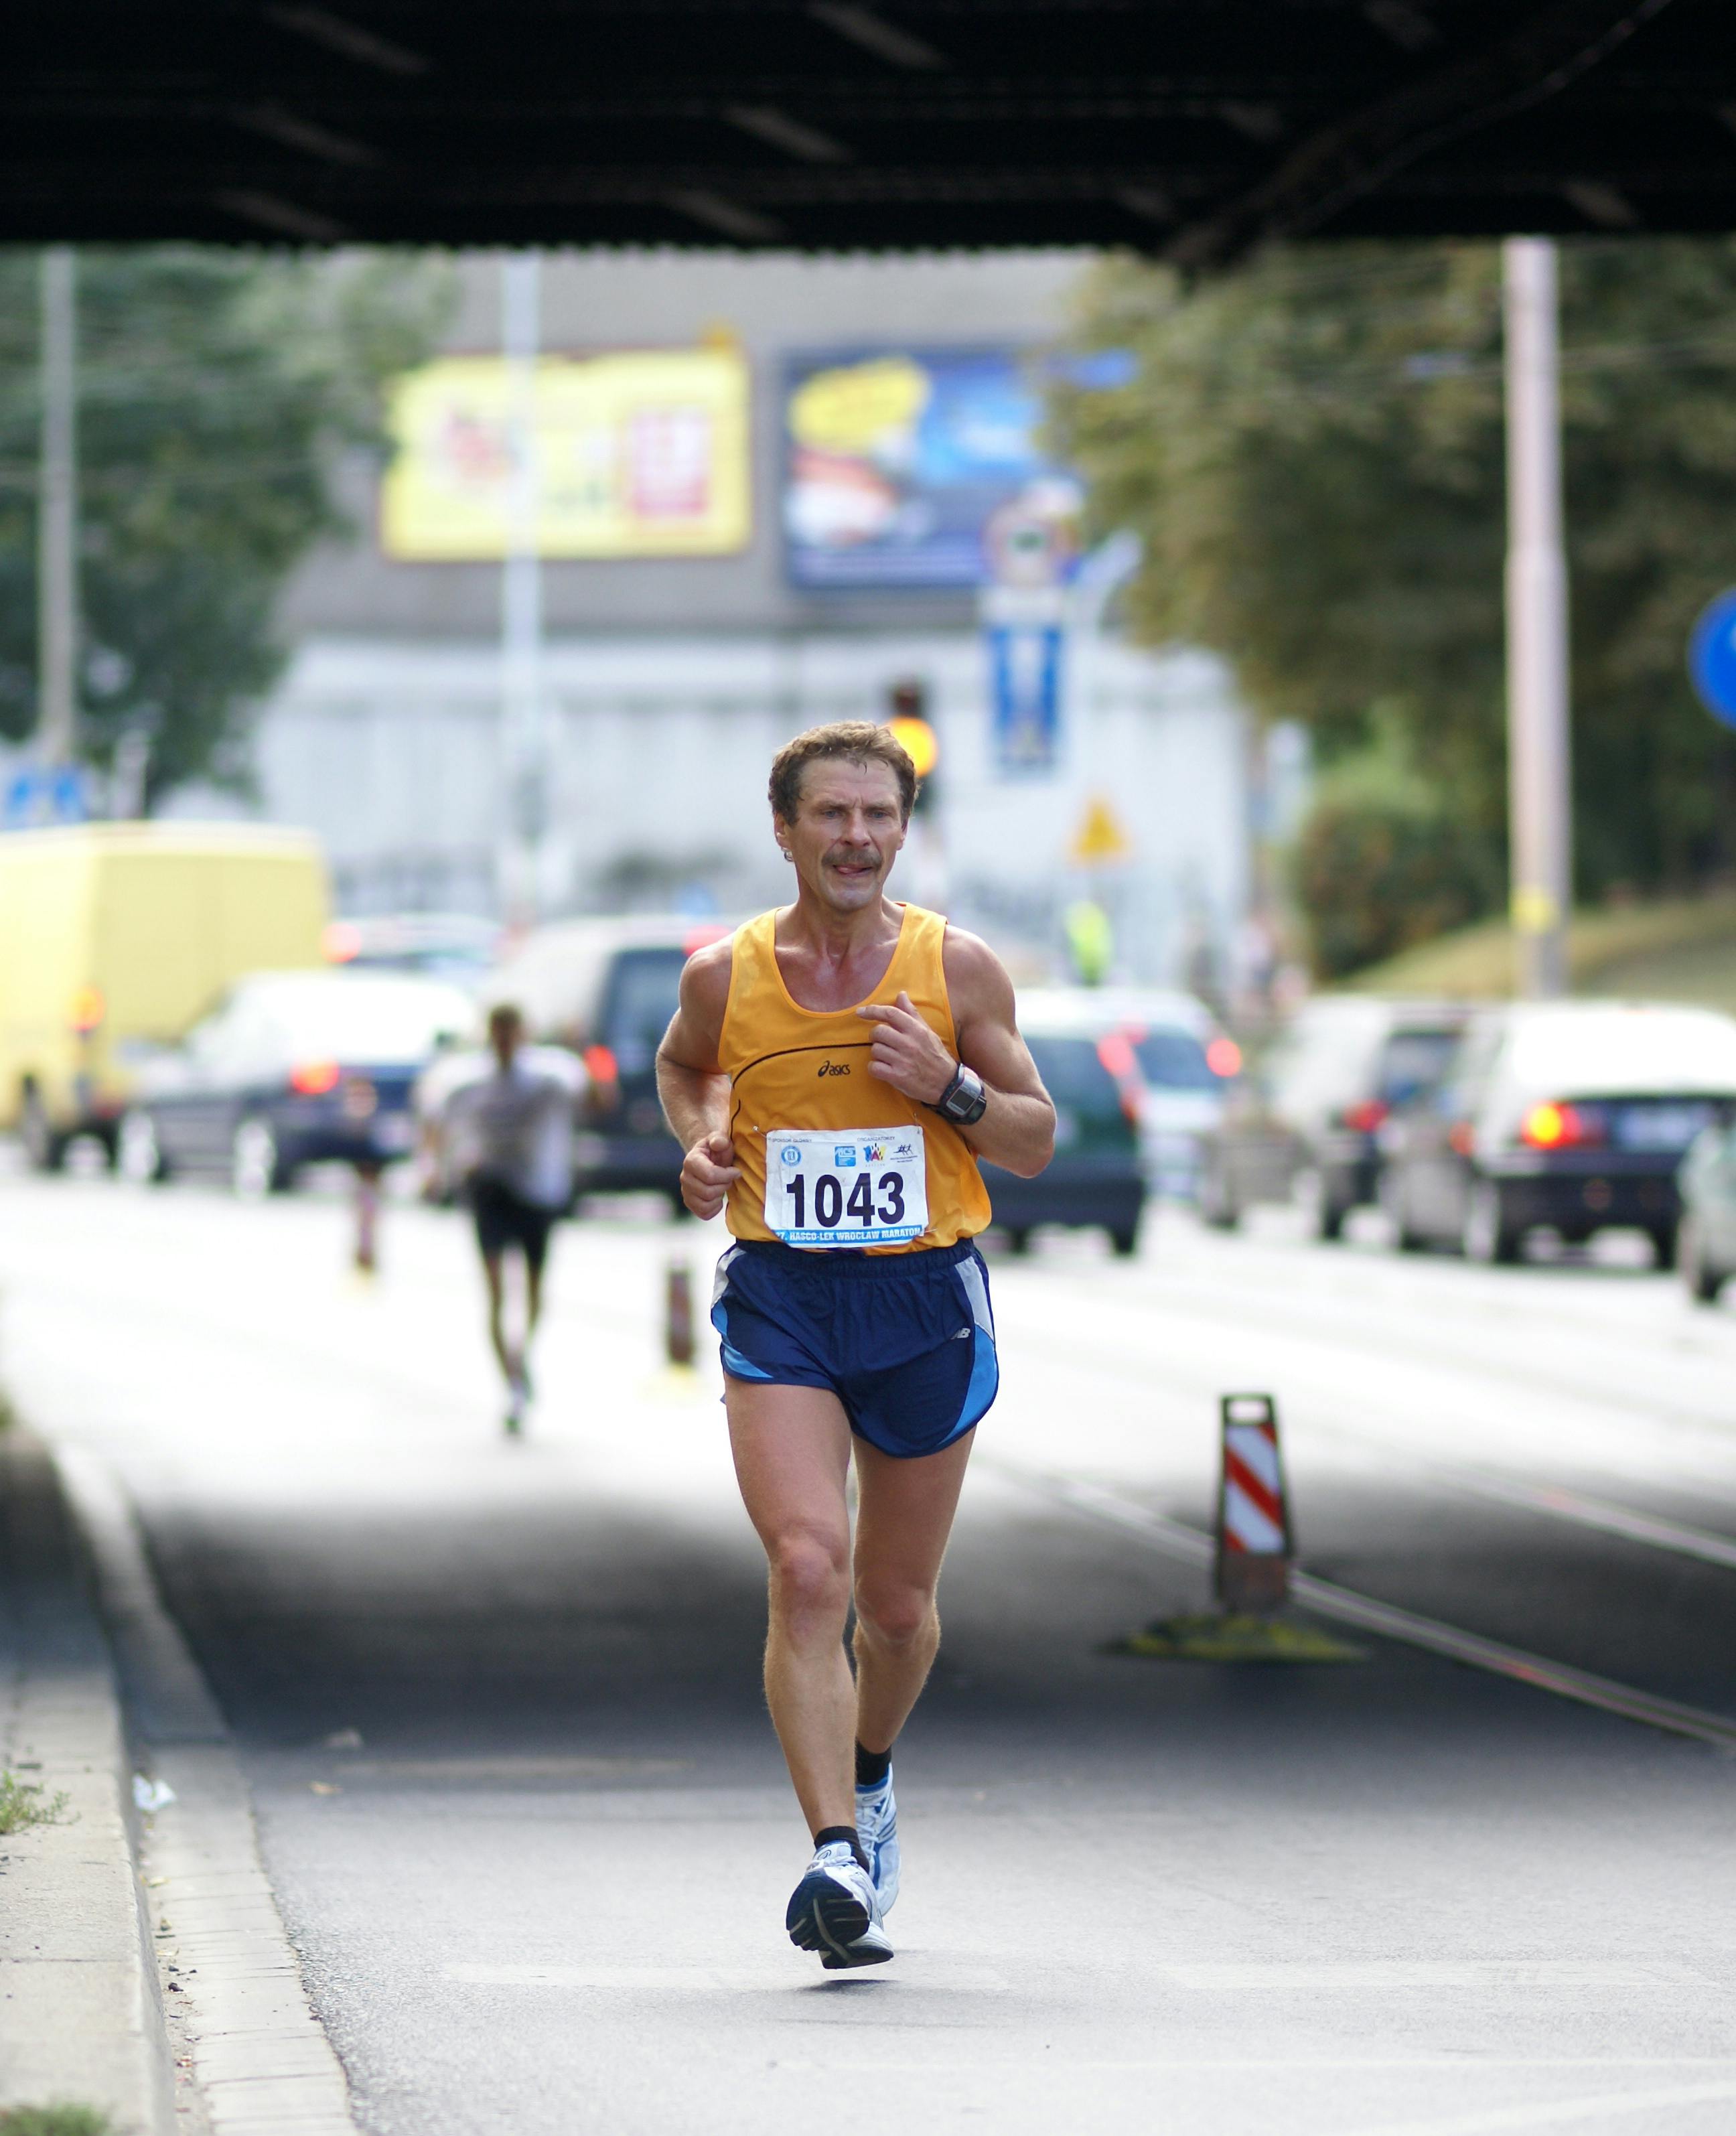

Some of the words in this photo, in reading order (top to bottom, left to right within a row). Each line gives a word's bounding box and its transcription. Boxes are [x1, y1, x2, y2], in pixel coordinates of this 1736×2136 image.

[828, 1064, 851, 1076] asics
[786, 1171, 905, 1228] 1043
[790, 1231, 834, 1240] HASCO-LEK
[881, 1227, 920, 1238] MARATON
